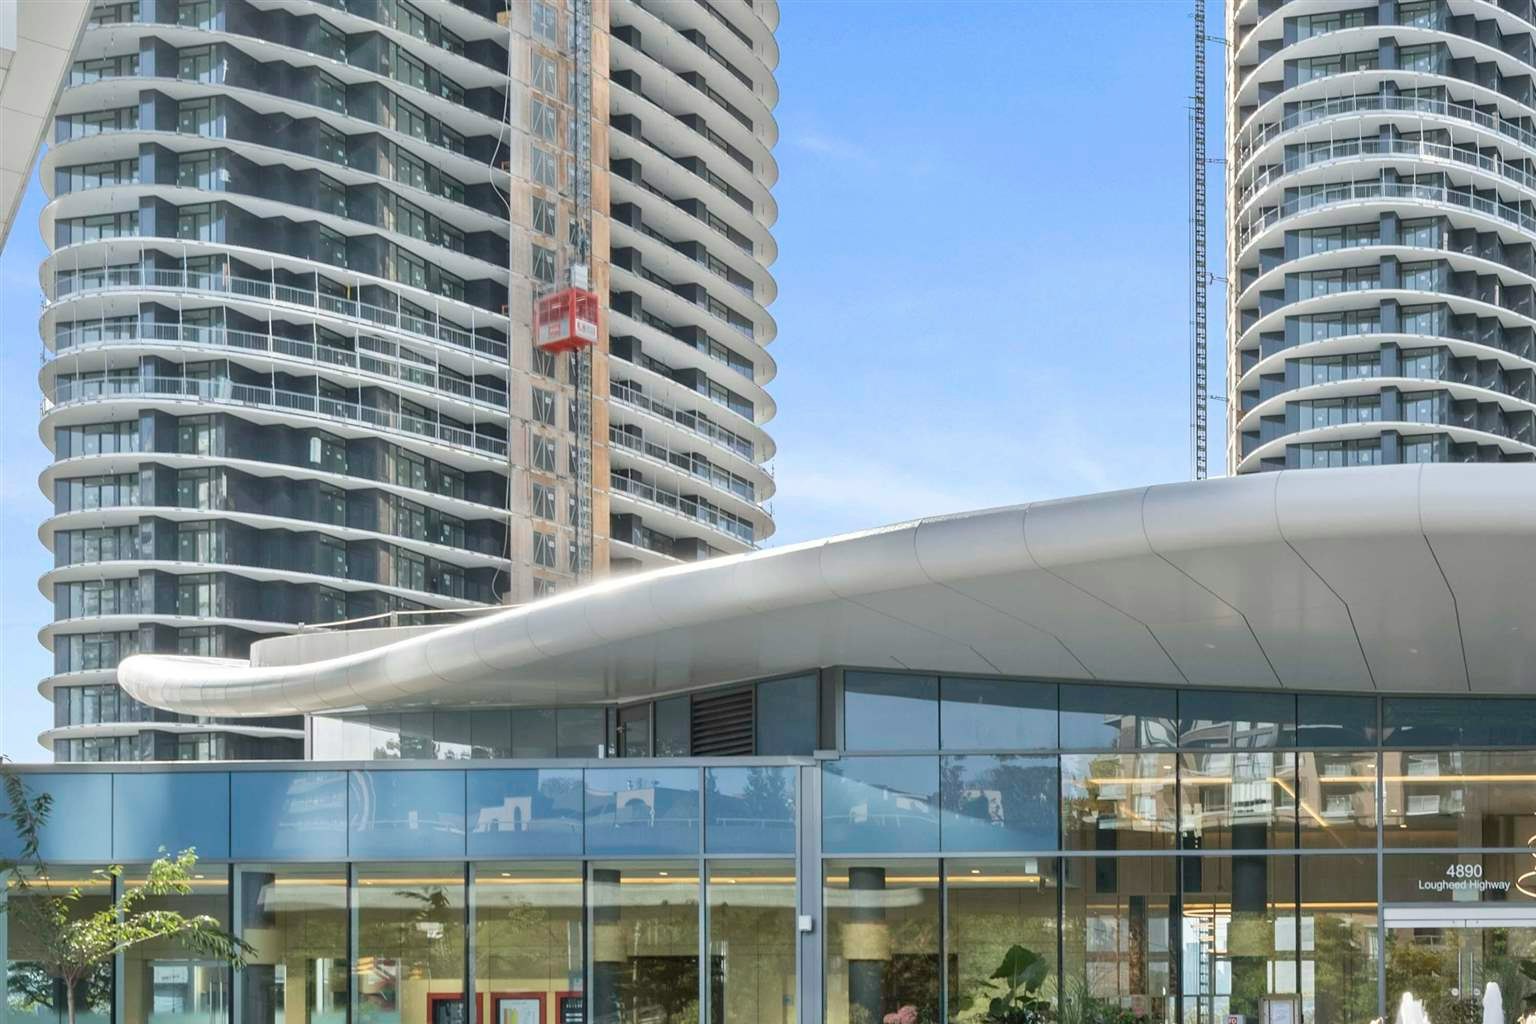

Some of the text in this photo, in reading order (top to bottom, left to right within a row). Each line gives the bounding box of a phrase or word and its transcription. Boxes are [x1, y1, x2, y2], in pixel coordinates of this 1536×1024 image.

[1446, 863, 1483, 878] 4890
[1418, 880, 1511, 892] Lougheed Highway
